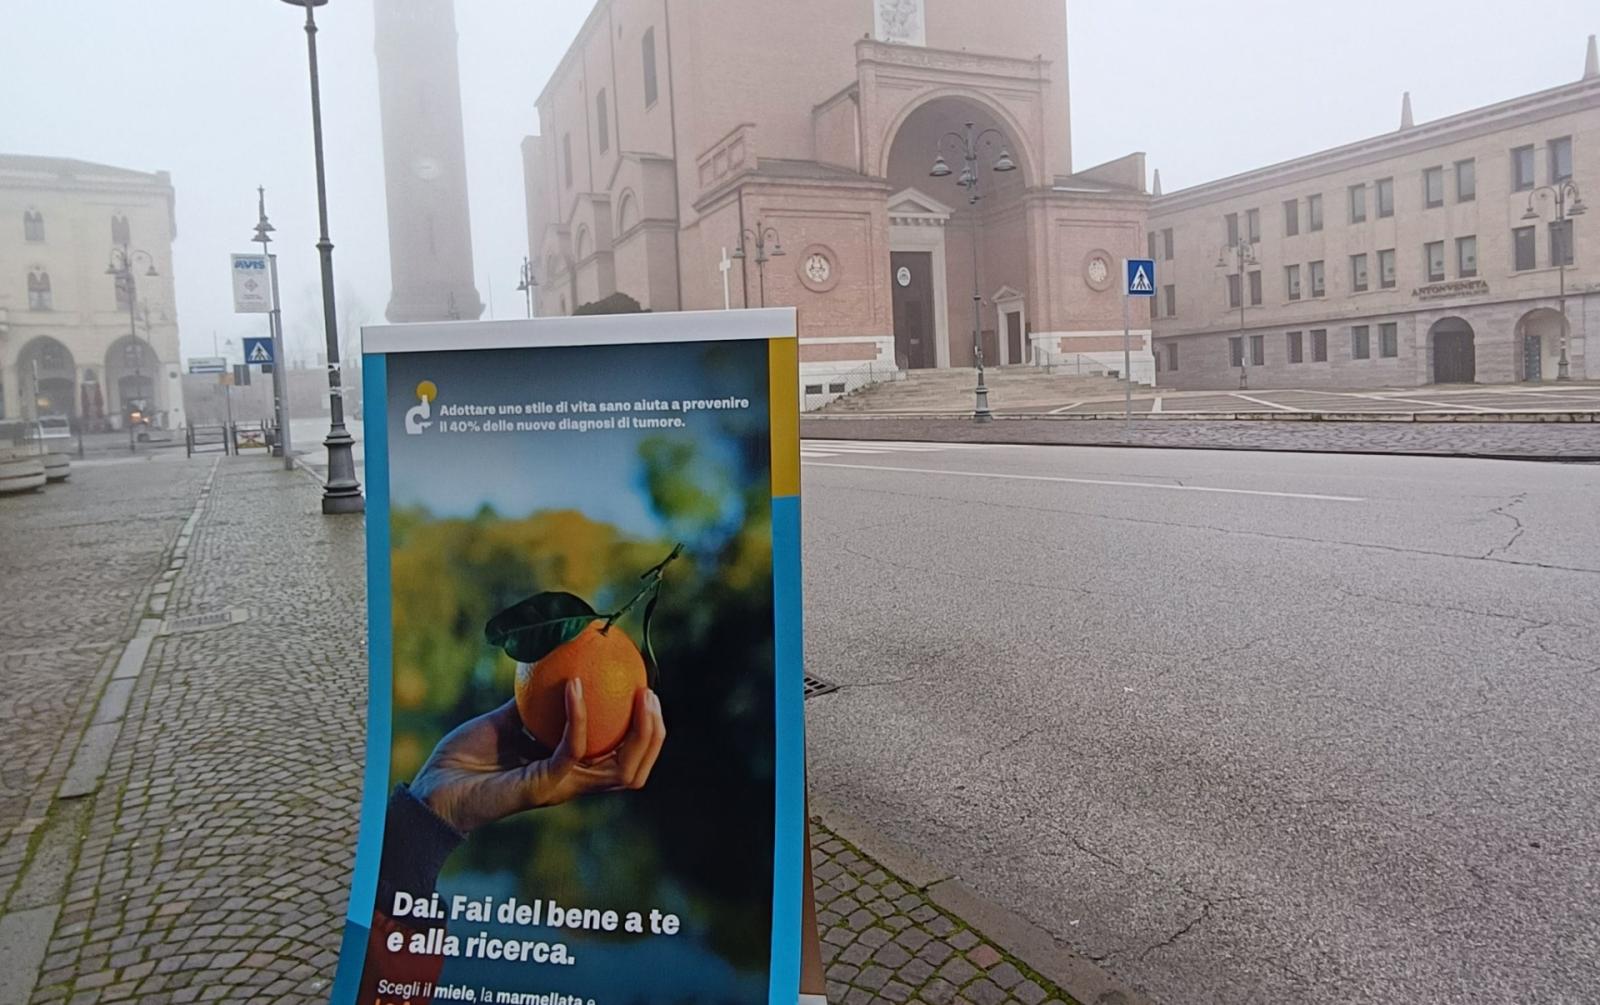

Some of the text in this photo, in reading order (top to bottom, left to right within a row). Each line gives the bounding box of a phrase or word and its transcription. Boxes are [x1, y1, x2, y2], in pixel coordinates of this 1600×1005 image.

[234, 260, 265, 269] AVIS
[439, 396, 750, 416] Adottare uno stile di vita sano aiuta a prevenire
[449, 420, 481, 433] 40%
[482, 419, 514, 432] delle
[516, 418, 556, 431] nuove
[558, 417, 615, 432] diagnosi
[617, 417, 631, 429] di
[632, 417, 686, 428] tumore.
[392, 891, 681, 935] Dai. Fai del bene a te
[386, 927, 576, 965] e alla ricerca.
[377, 979, 421, 1000] Scegli
[422, 982, 432, 997] il
[433, 983, 477, 1004] miele,
[480, 986, 493, 1002] la
[496, 991, 582, 1005] marmellata
